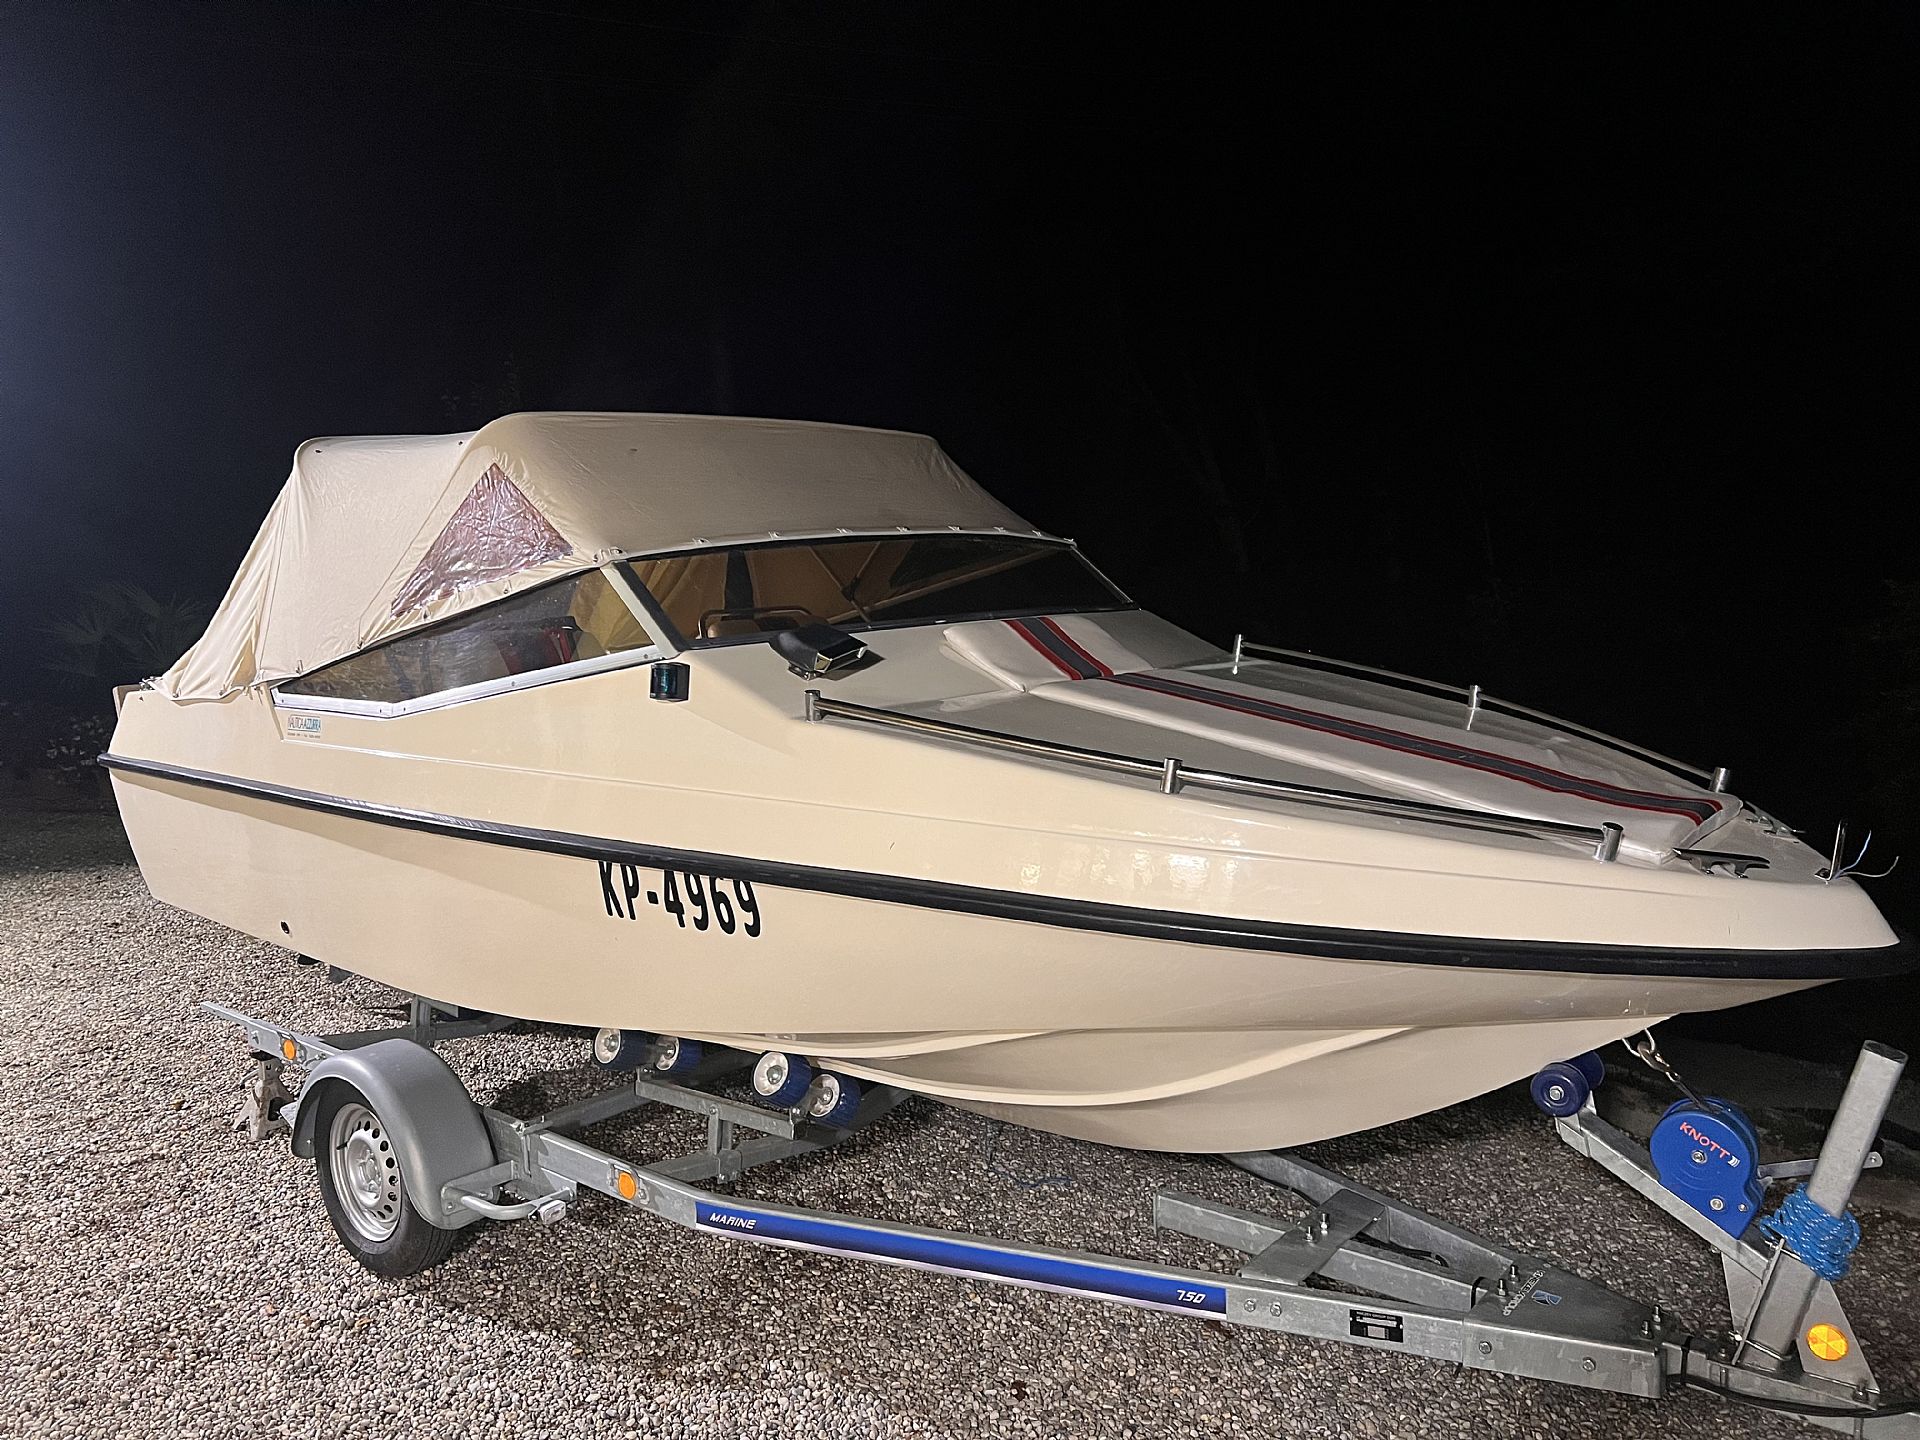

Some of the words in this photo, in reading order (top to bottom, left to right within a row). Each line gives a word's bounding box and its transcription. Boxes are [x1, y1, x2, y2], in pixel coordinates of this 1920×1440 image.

[598, 860, 761, 938] KP-4969
[1680, 1121, 1730, 1158] KNOTT
[709, 1212, 757, 1230] MARINE
[1176, 1289, 1206, 1304] 750
